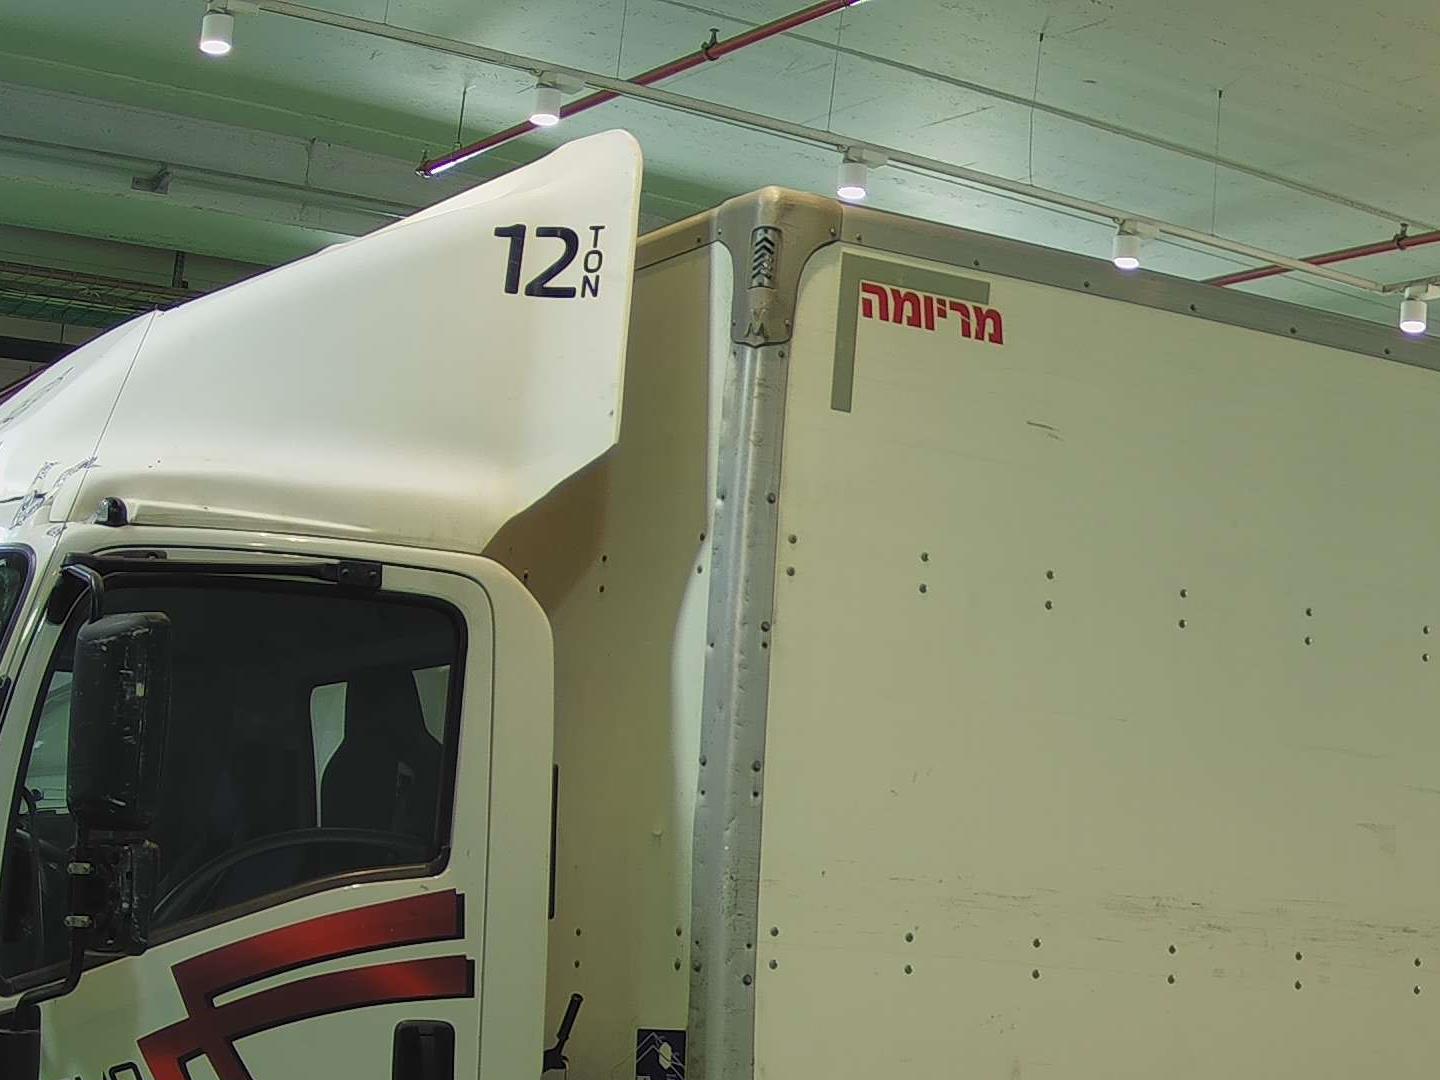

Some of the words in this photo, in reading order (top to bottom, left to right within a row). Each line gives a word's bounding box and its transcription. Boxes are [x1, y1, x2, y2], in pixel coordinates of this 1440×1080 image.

[494, 224, 579, 298] 12
[581, 225, 606, 298] TON
[861, 281, 1004, 345] מריומה
